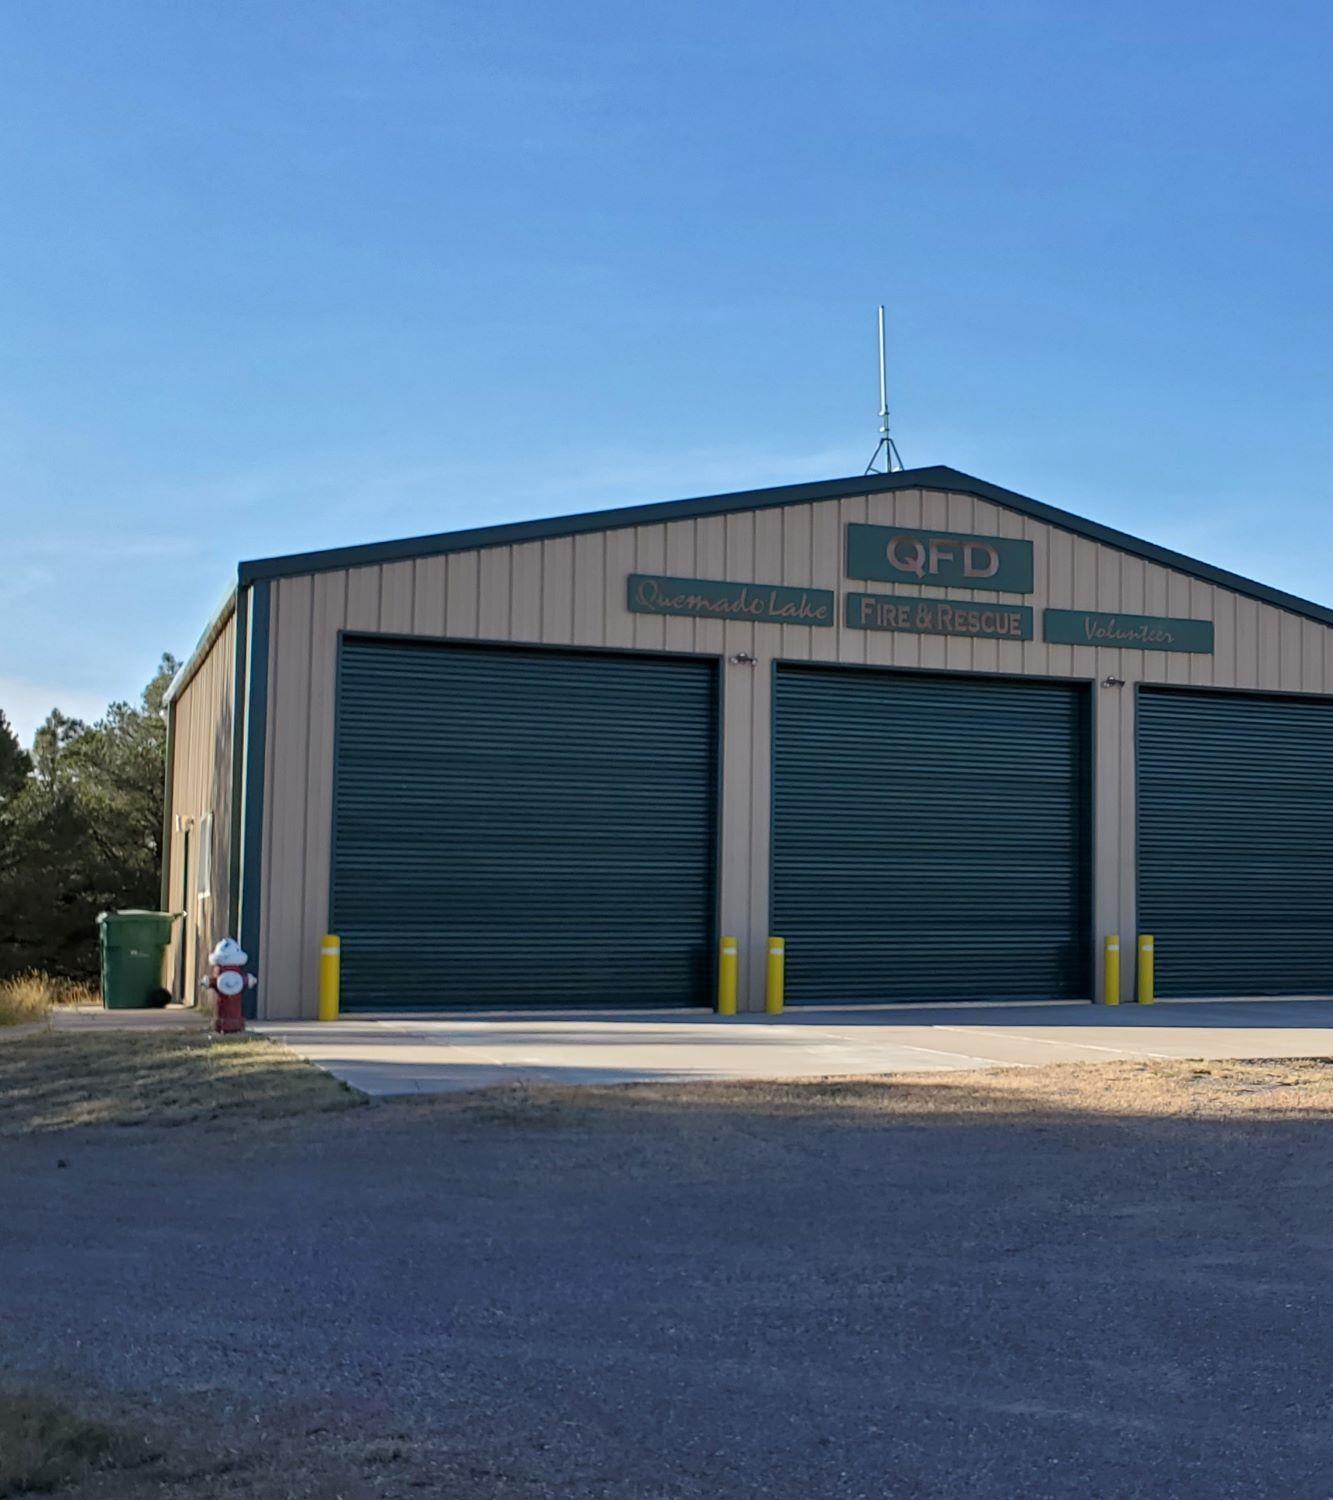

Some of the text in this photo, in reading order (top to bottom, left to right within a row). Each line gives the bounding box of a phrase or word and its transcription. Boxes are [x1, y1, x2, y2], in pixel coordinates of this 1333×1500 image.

[887, 535, 999, 579] QFD
[637, 579, 829, 620] Quemado Lake
[915, 604, 932, 630] &
[1085, 616, 1175, 644] Volunteer
